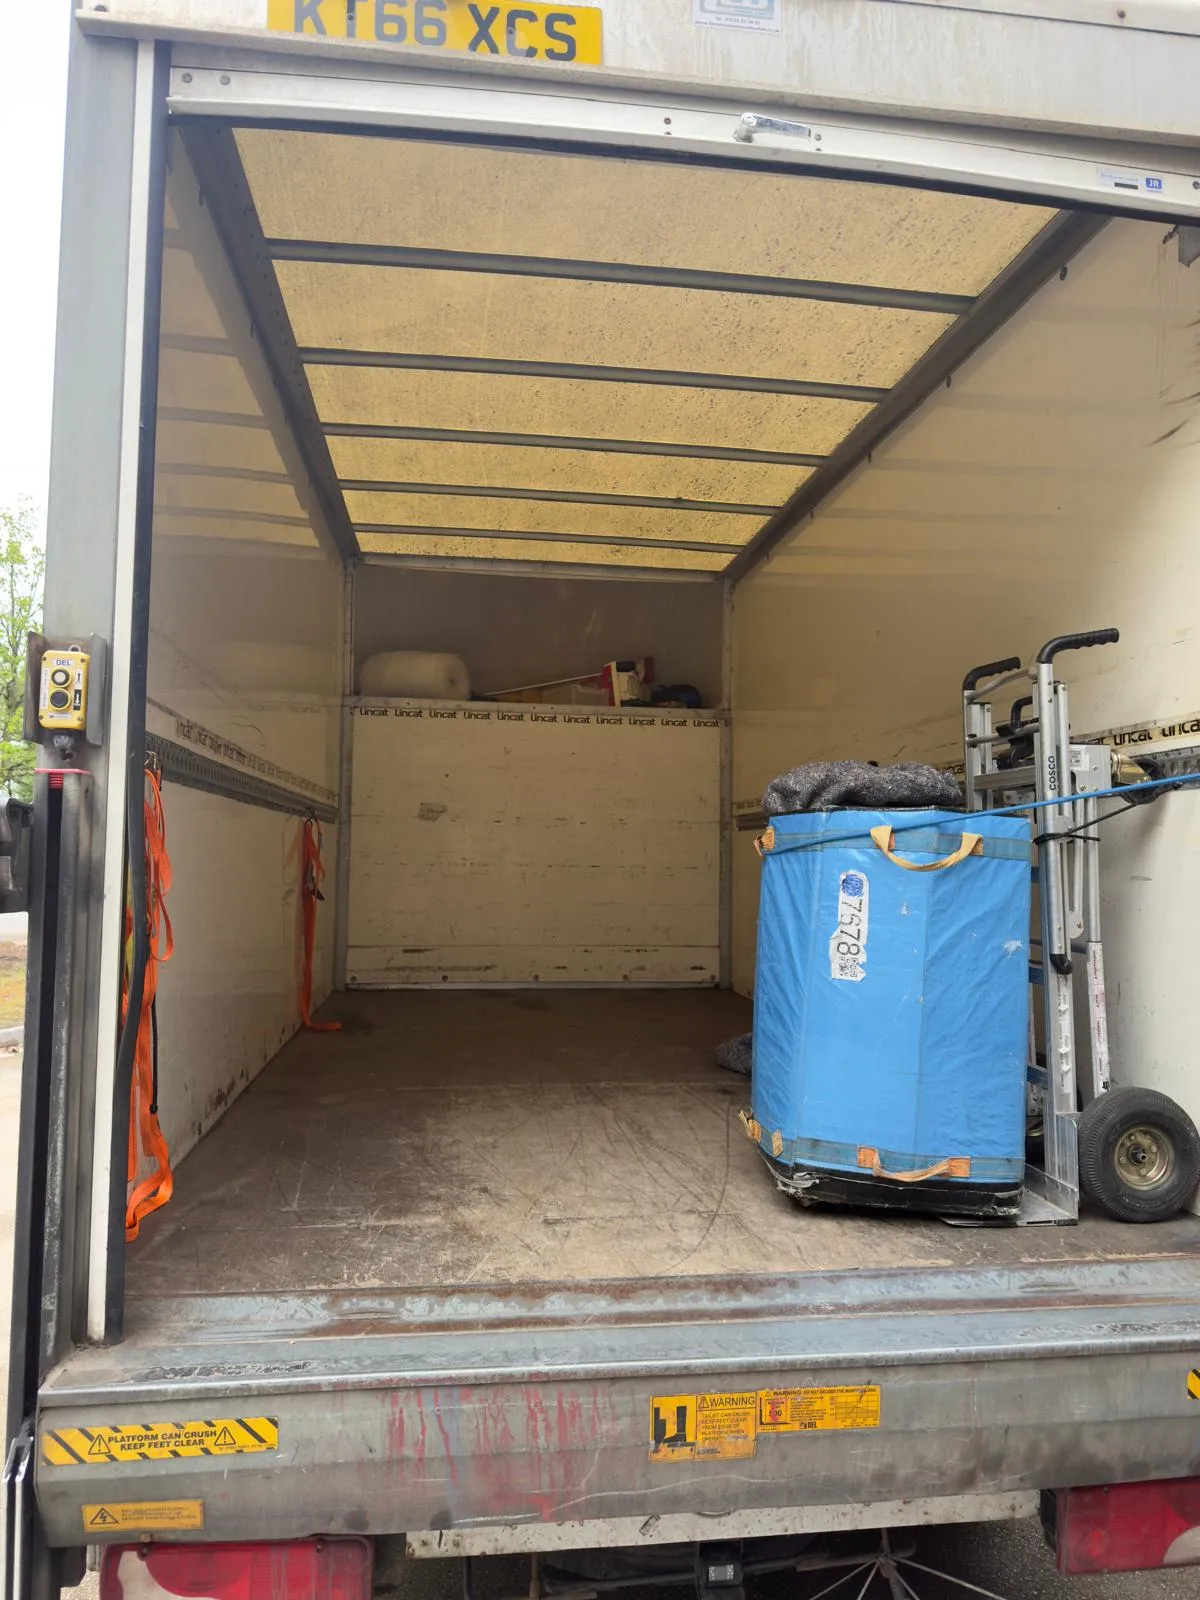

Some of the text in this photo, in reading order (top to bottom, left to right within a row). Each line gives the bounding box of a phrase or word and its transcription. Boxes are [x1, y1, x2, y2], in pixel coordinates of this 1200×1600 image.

[293, 0, 577, 61] KT66 XCS
[1148, 179, 1160, 187] JR
[360, 707, 389, 717] Lincat
[394, 708, 424, 718] Lincat
[429, 708, 457, 719] Lincat
[463, 711, 491, 720] Lincat
[497, 712, 524, 721] Lincat
[530, 713, 558, 722] Lincat
[563, 715, 591, 724] Lincat
[596, 716, 623, 725] Lincat
[628, 717, 656, 726] Lincat
[661, 718, 688, 727] Lincat
[693, 719, 720, 728] Lincat
[1048, 756, 1056, 791] COSCO
[709, 1395, 755, 1407] WARNING
[108, 1430, 217, 1443] PLATFORM CAN CRUSH
[120, 1439, 205, 1451] KEEP FEET CLEAR
